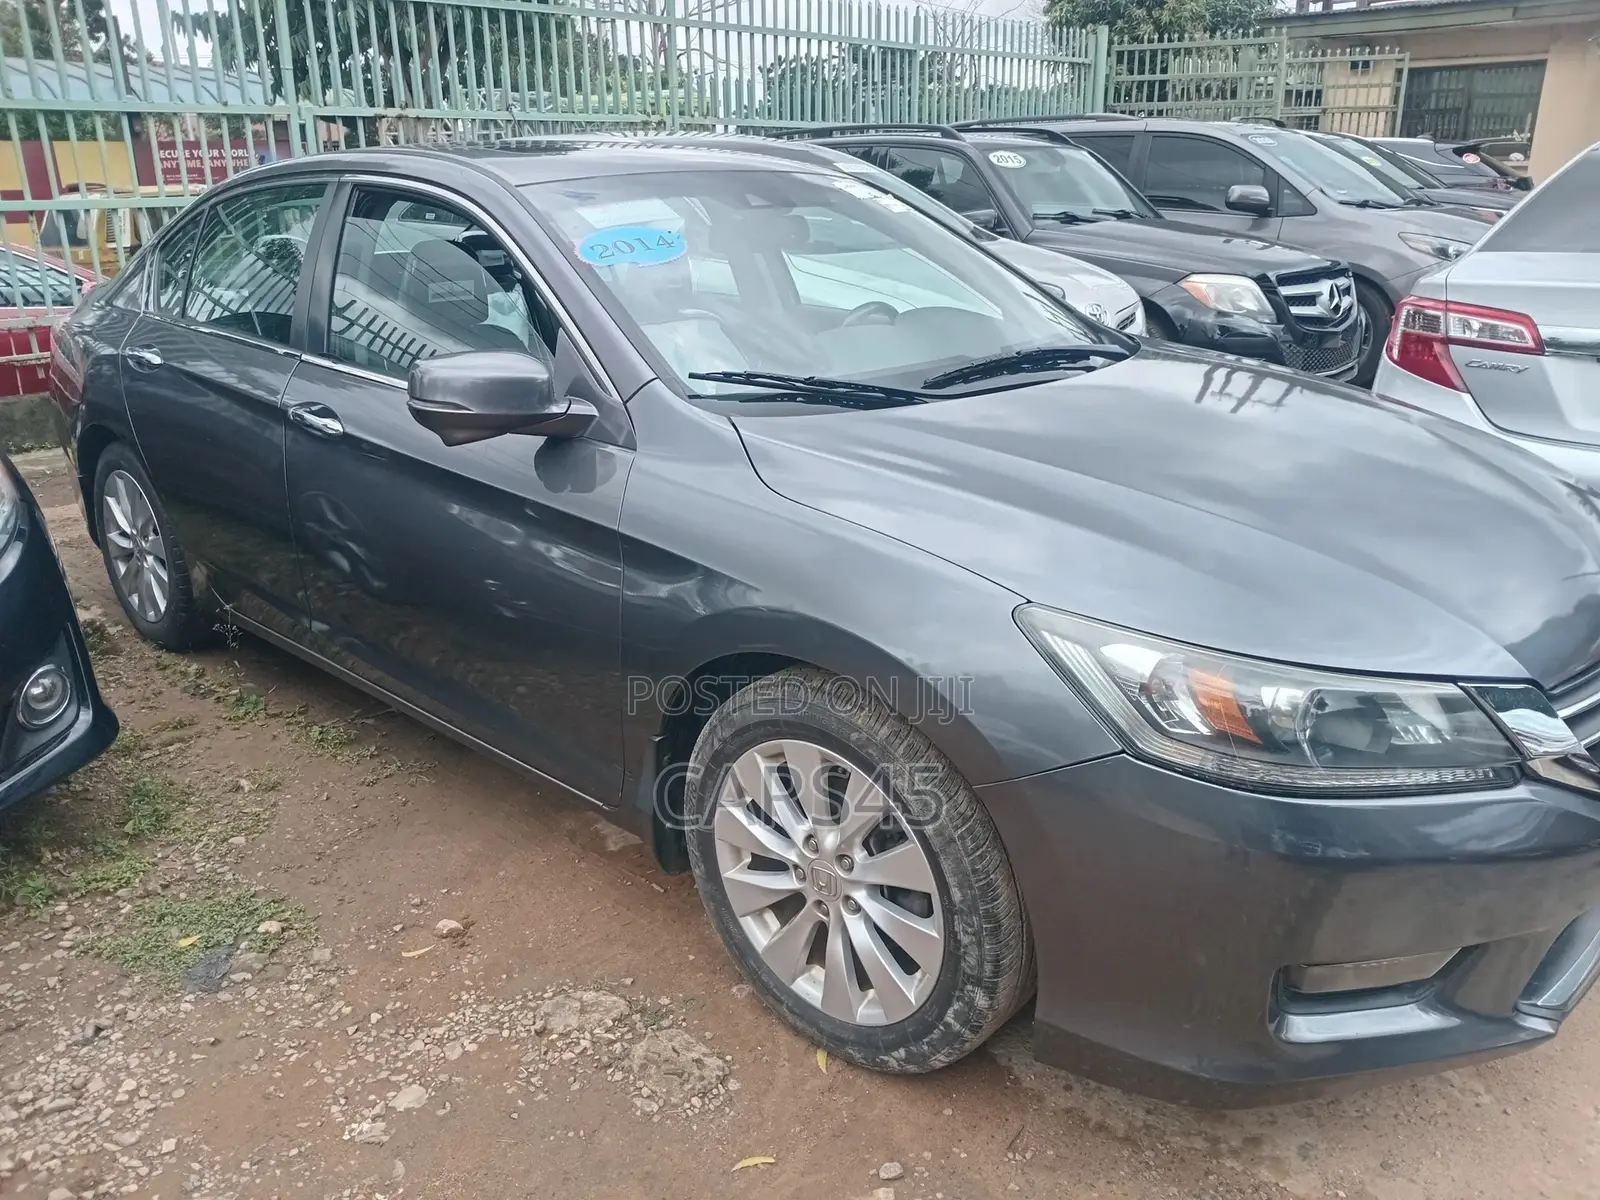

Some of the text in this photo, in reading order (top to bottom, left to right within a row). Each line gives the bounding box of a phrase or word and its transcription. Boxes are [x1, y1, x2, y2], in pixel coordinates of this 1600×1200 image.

[158, 149, 191, 159] ECUE
[220, 148, 259, 158] ORL,
[993, 154, 1022, 164] 2015
[589, 234, 675, 260] 2014
[1464, 358, 1530, 374] CAMRY
